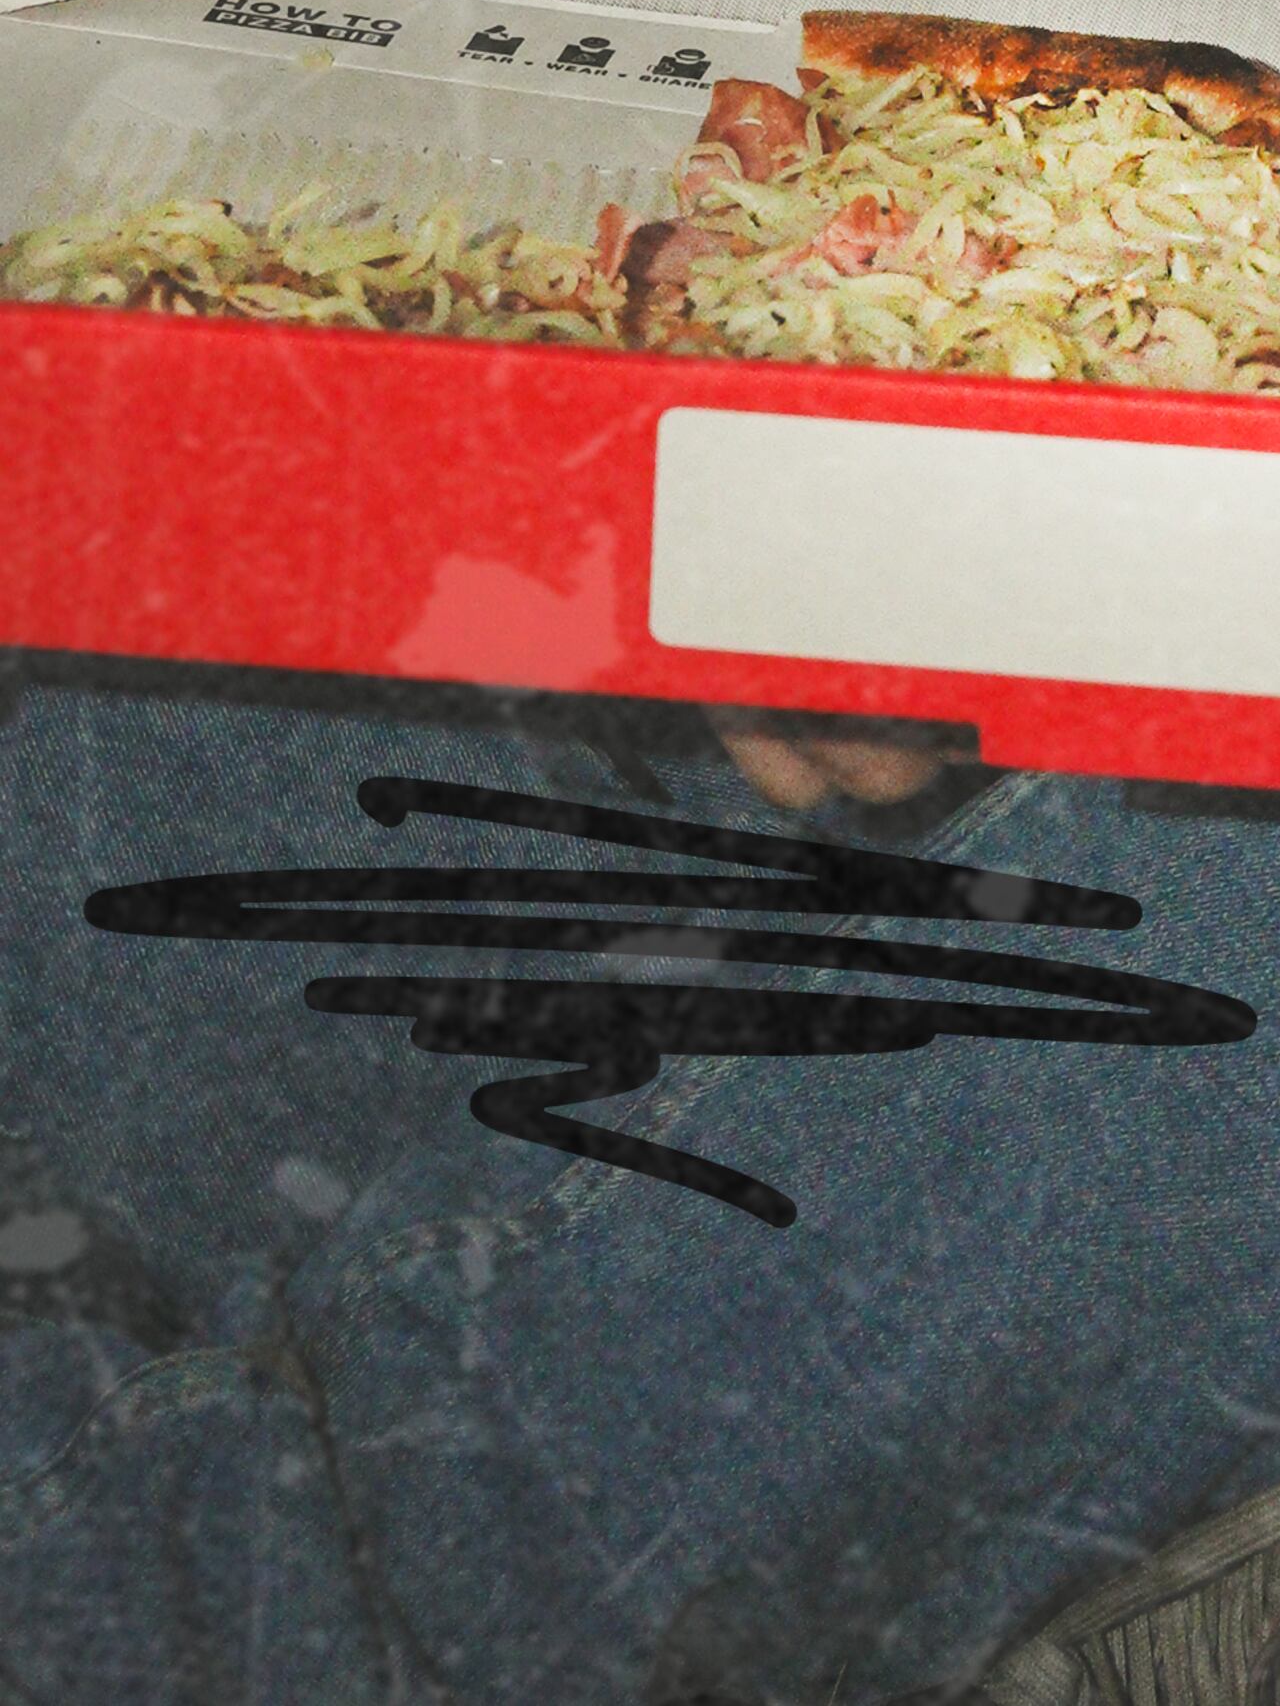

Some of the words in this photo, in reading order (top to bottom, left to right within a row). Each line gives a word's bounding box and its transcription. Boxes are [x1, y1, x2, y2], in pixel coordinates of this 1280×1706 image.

[215, 11, 314, 34] PIZZA
[325, 28, 383, 44] BIB
[341, 13, 403, 32] TO
[457, 50, 515, 64] TEAR
[546, 62, 609, 76] WEAR
[639, 75, 712, 90] SHARE
